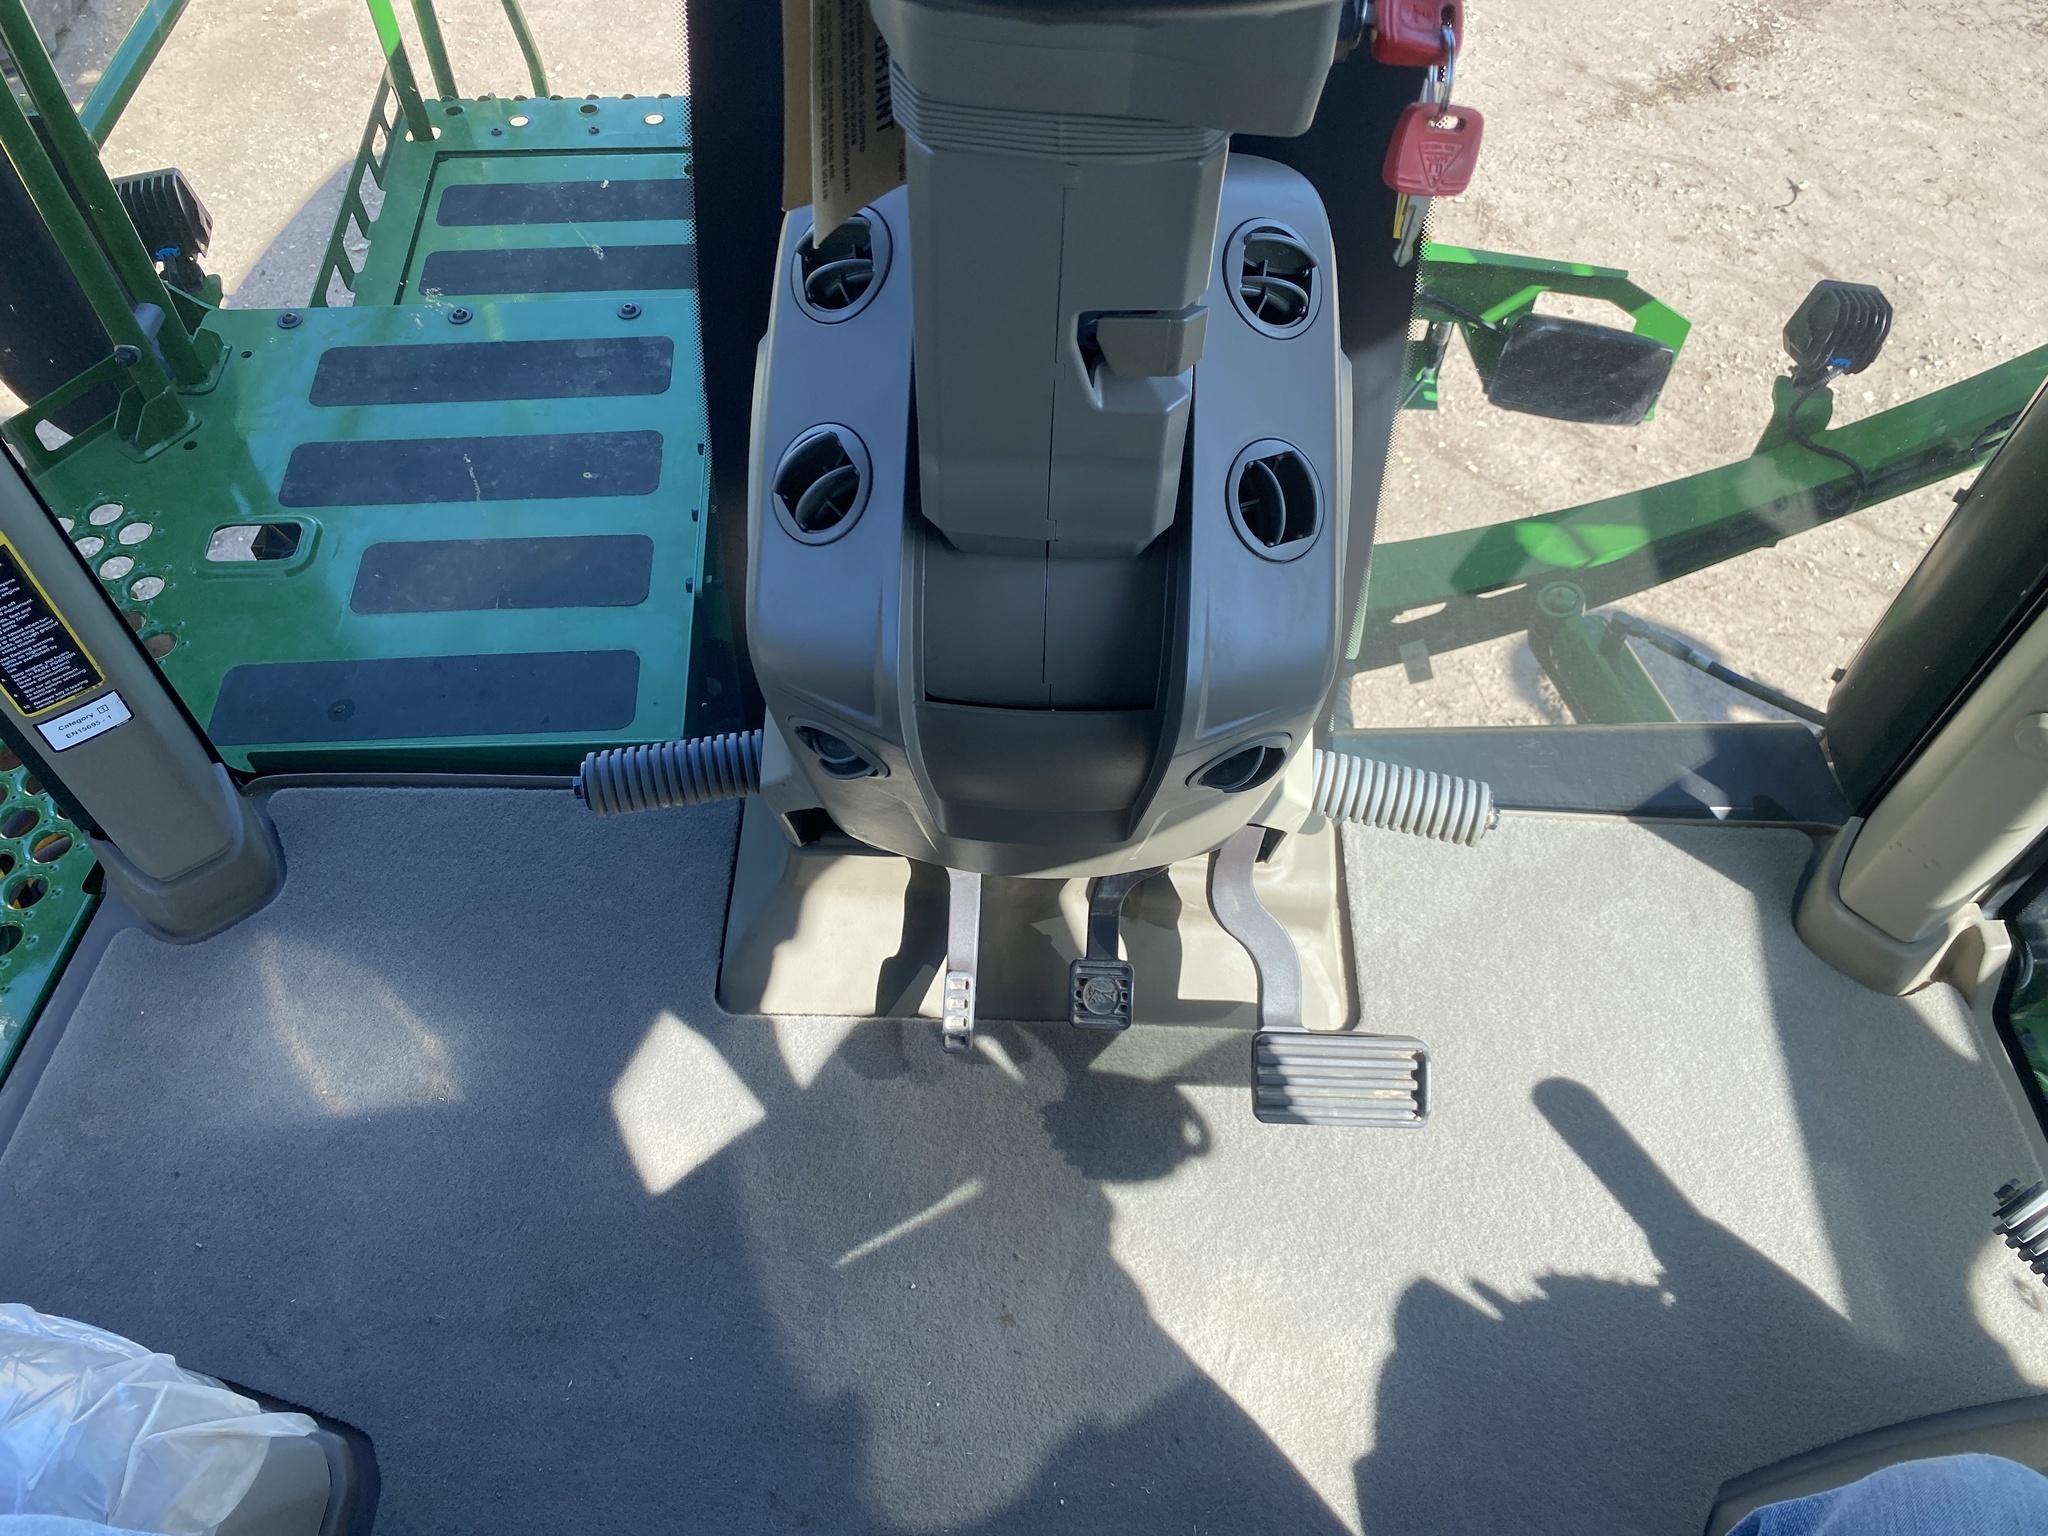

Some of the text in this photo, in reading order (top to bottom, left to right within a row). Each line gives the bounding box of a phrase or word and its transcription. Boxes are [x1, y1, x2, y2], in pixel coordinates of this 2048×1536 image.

[50, 651, 76, 667] POSITION
[33, 695, 55, 706] Remove
[58, 713, 94, 731] Category
[65, 720, 101, 739] EN15695
